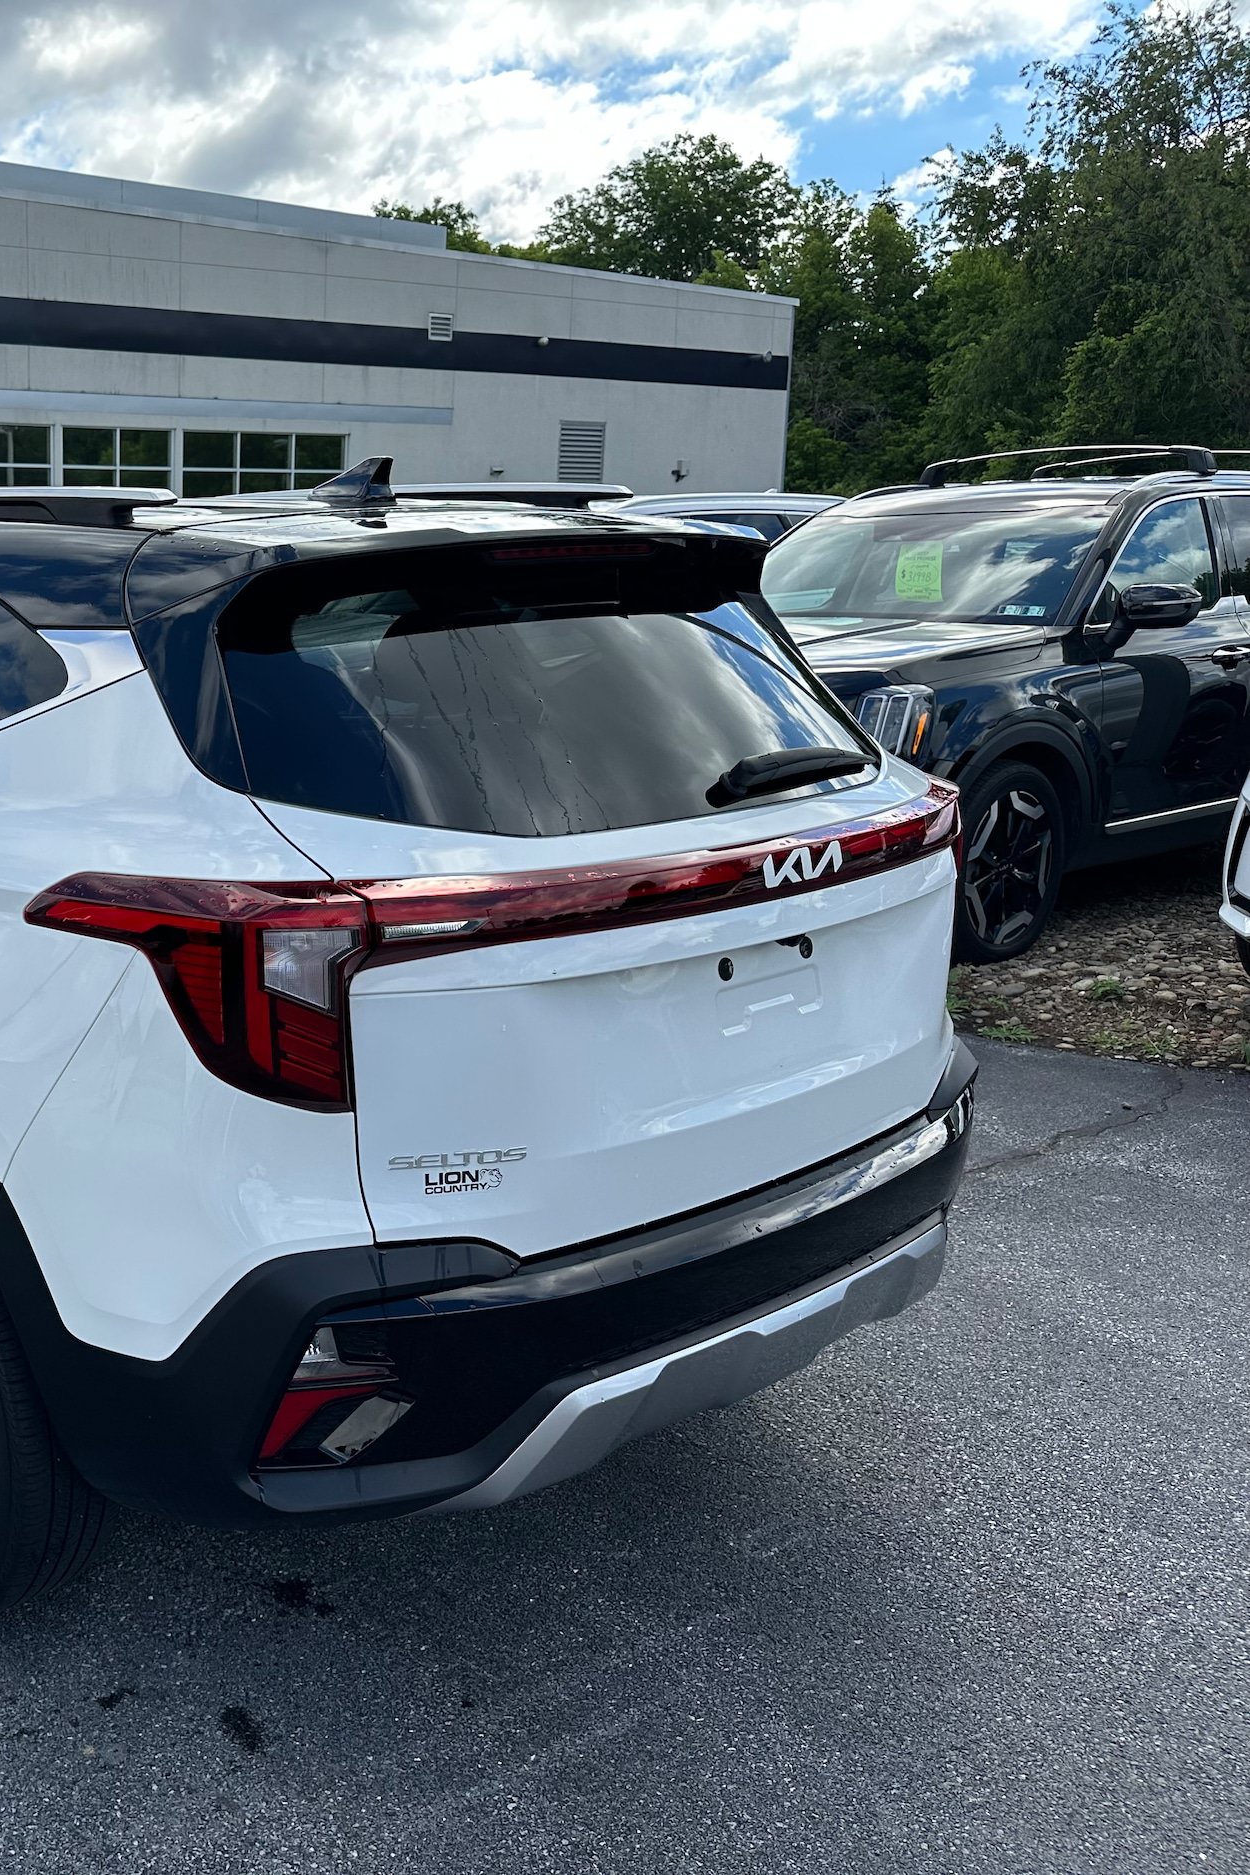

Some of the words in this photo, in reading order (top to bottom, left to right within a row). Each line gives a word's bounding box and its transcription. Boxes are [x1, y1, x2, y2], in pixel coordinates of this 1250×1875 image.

[763, 840, 843, 889] KIA
[388, 1146, 527, 1171] SELTOS
[425, 1170, 479, 1187] LION
[425, 1182, 488, 1195] COUNTRY
